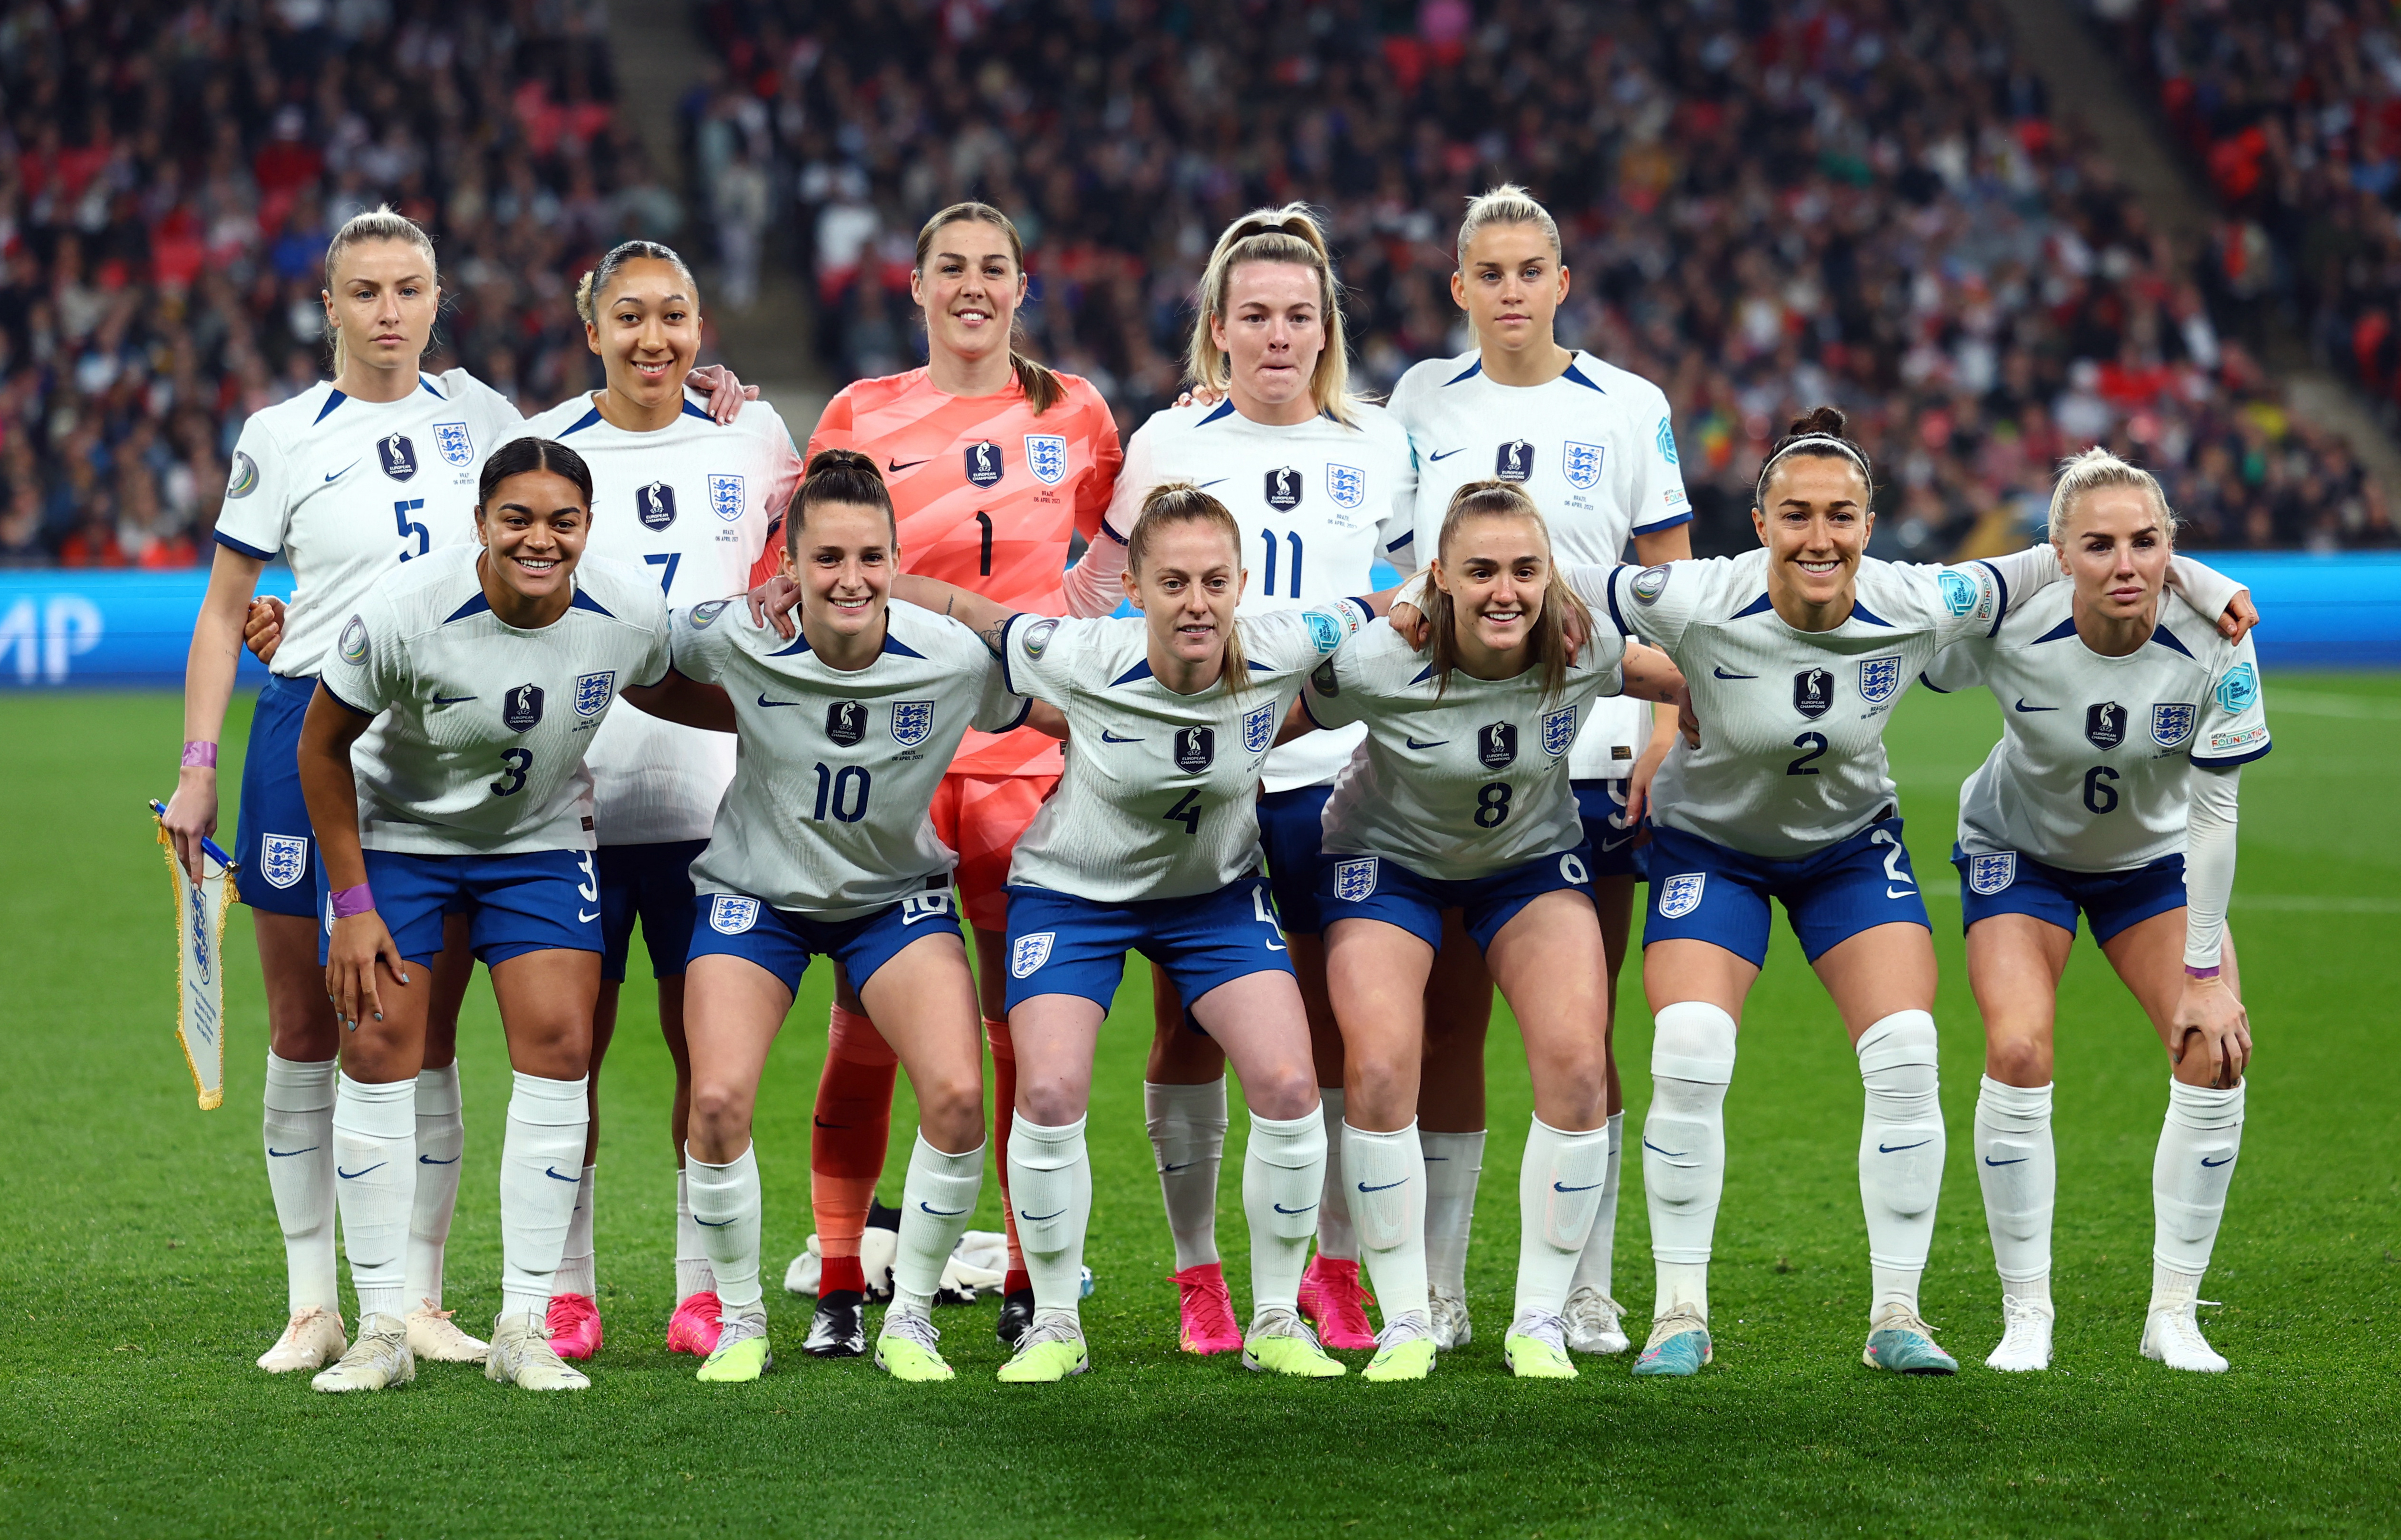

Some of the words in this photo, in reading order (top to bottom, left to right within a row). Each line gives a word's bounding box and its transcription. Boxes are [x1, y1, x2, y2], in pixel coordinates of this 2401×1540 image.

[394, 498, 429, 562] 5
[976, 510, 992, 576] 1
[643, 552, 682, 599] 7
[1261, 528, 1303, 599] 11
[1954, 591, 1958, 601] We
[1319, 628, 1323, 638] We
[1323, 619, 1331, 639] Strong
[2232, 688, 2250, 699] Strong
[1787, 732, 1828, 775] 2
[2212, 726, 2265, 747] FOUNDATION
[490, 747, 533, 797] 3
[814, 762, 871, 823] 10
[2083, 766, 2120, 814] 6
[1162, 788, 1201, 834] 4
[1474, 782, 1512, 828] 8
[1871, 829, 1914, 884] 2
